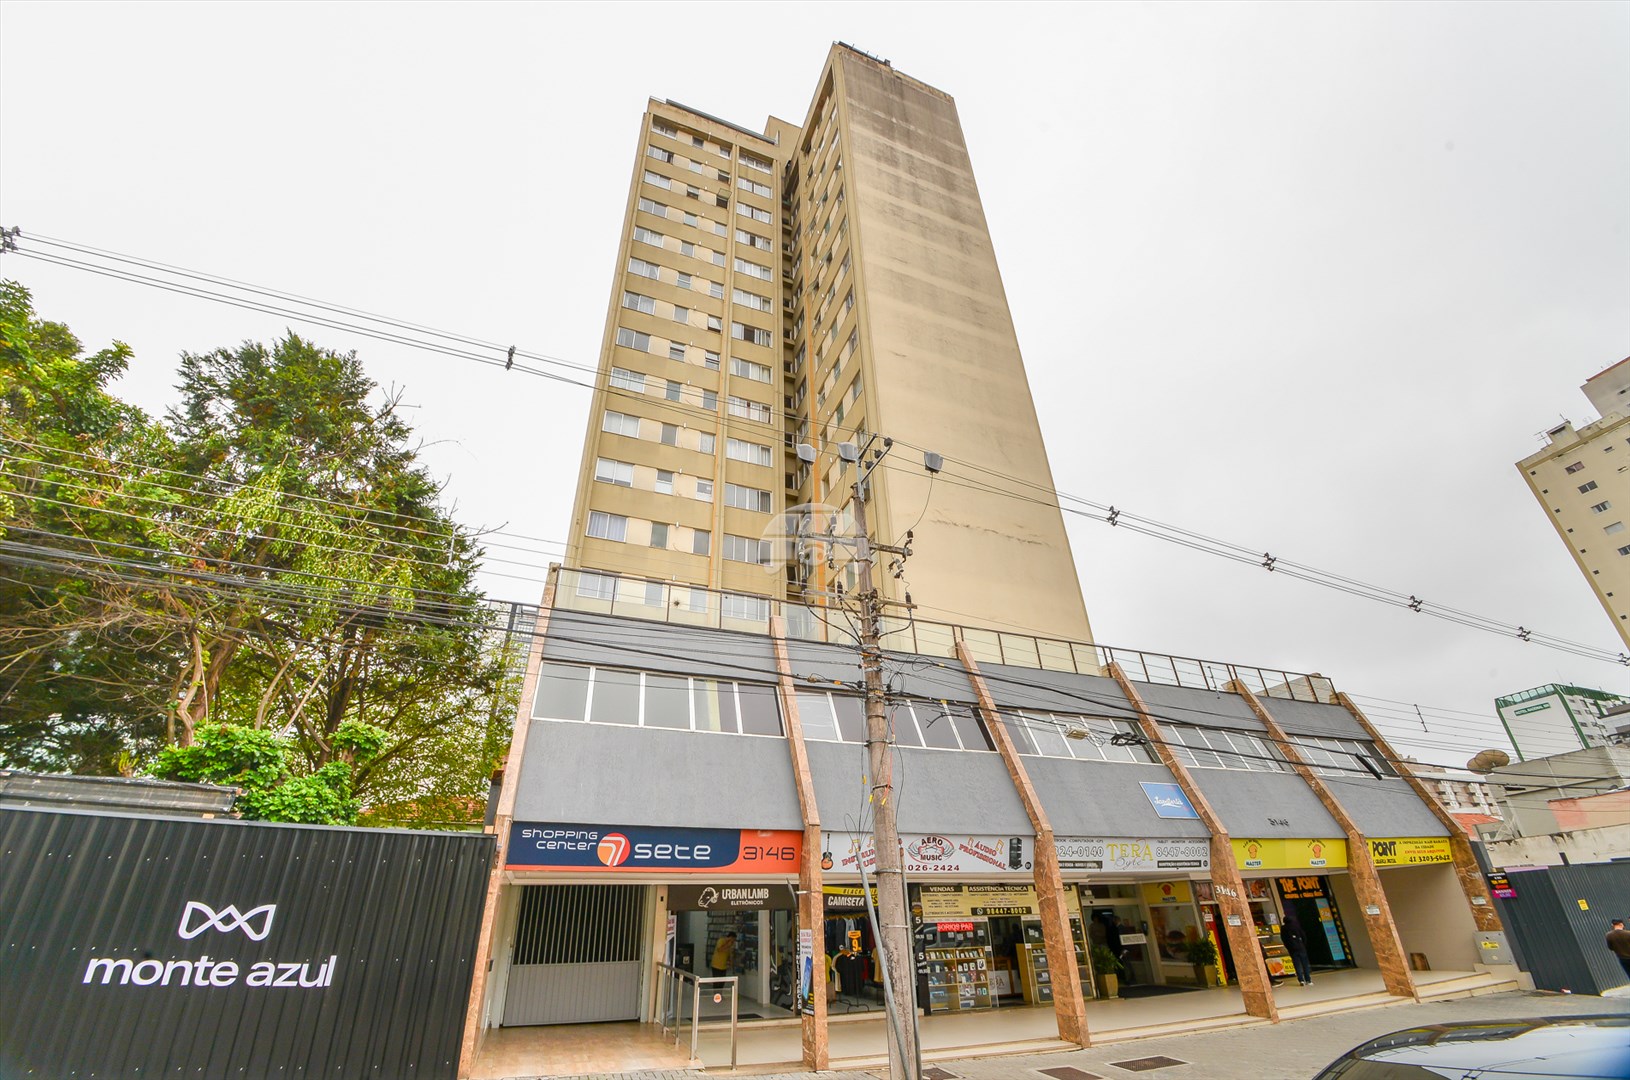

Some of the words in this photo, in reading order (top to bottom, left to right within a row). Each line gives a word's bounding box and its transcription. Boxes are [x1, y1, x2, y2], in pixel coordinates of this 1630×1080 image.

[921, 836, 943, 846] AERO
[974, 841, 997, 857] ÁUDIO
[1372, 841, 1397, 857] POINT
[536, 840, 597, 851] center
[634, 843, 711, 860] sete
[742, 846, 795, 861] 3146
[959, 843, 1007, 870] PROFISSIONAL
[1106, 843, 1153, 861] TERA
[1156, 847, 1208, 857] 8447-8002
[1215, 885, 1237, 897] 3146
[1279, 878, 1297, 893] THE
[1296, 877, 1320, 890] POINT
[828, 896, 864, 906] CAMISETA
[986, 907, 1028, 915] 98447-8002
[82, 956, 240, 986] monte
[246, 955, 337, 988] azul
